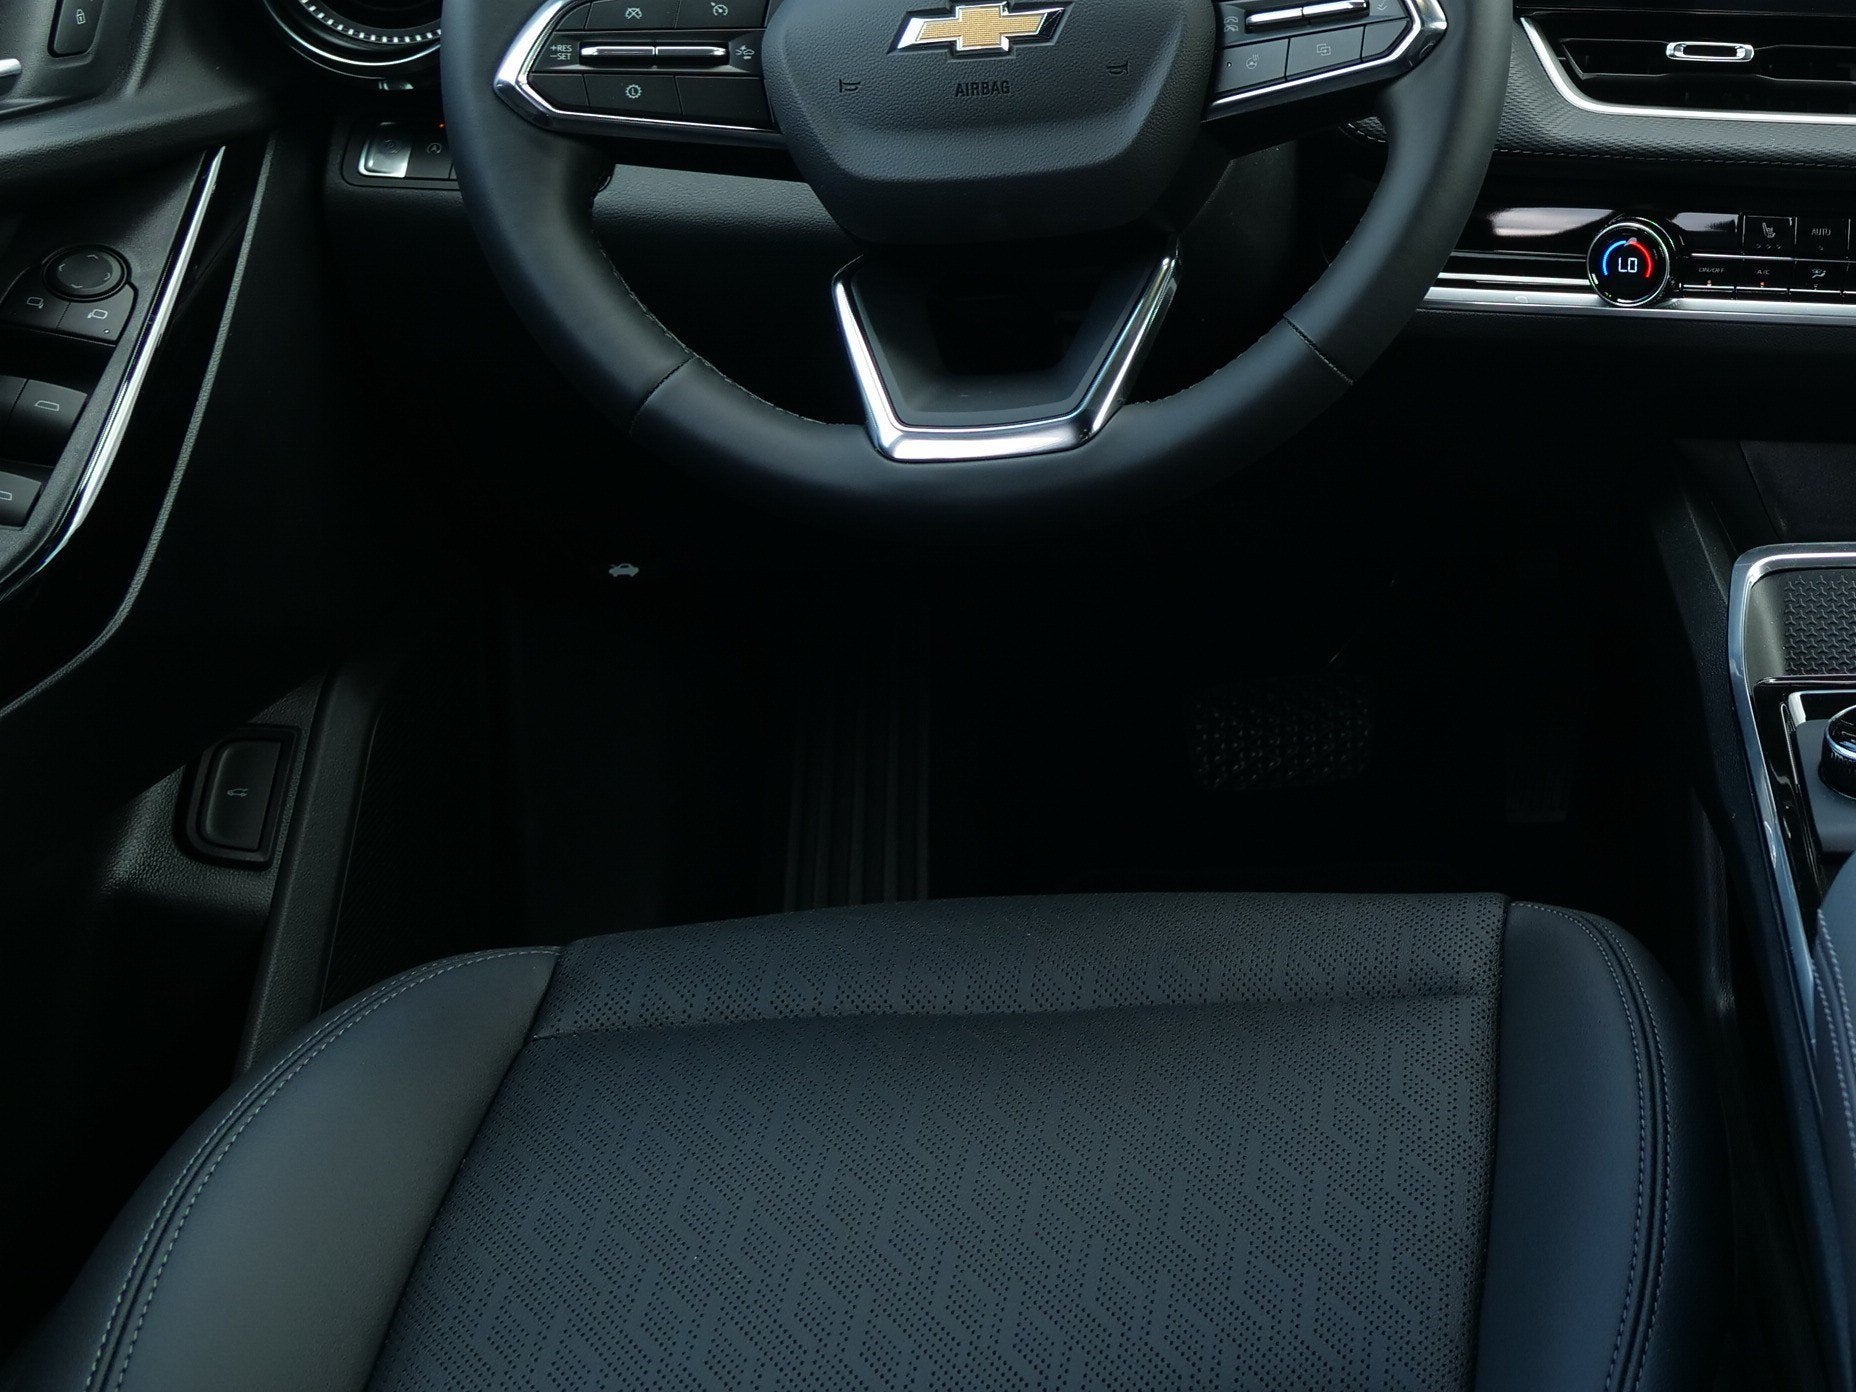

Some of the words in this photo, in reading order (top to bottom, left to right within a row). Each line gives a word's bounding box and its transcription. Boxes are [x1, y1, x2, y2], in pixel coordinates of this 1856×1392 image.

[955, 80, 1011, 98] AIRBAG
[1811, 228, 1831, 237] AUTO
[1618, 257, 1638, 273] LO
